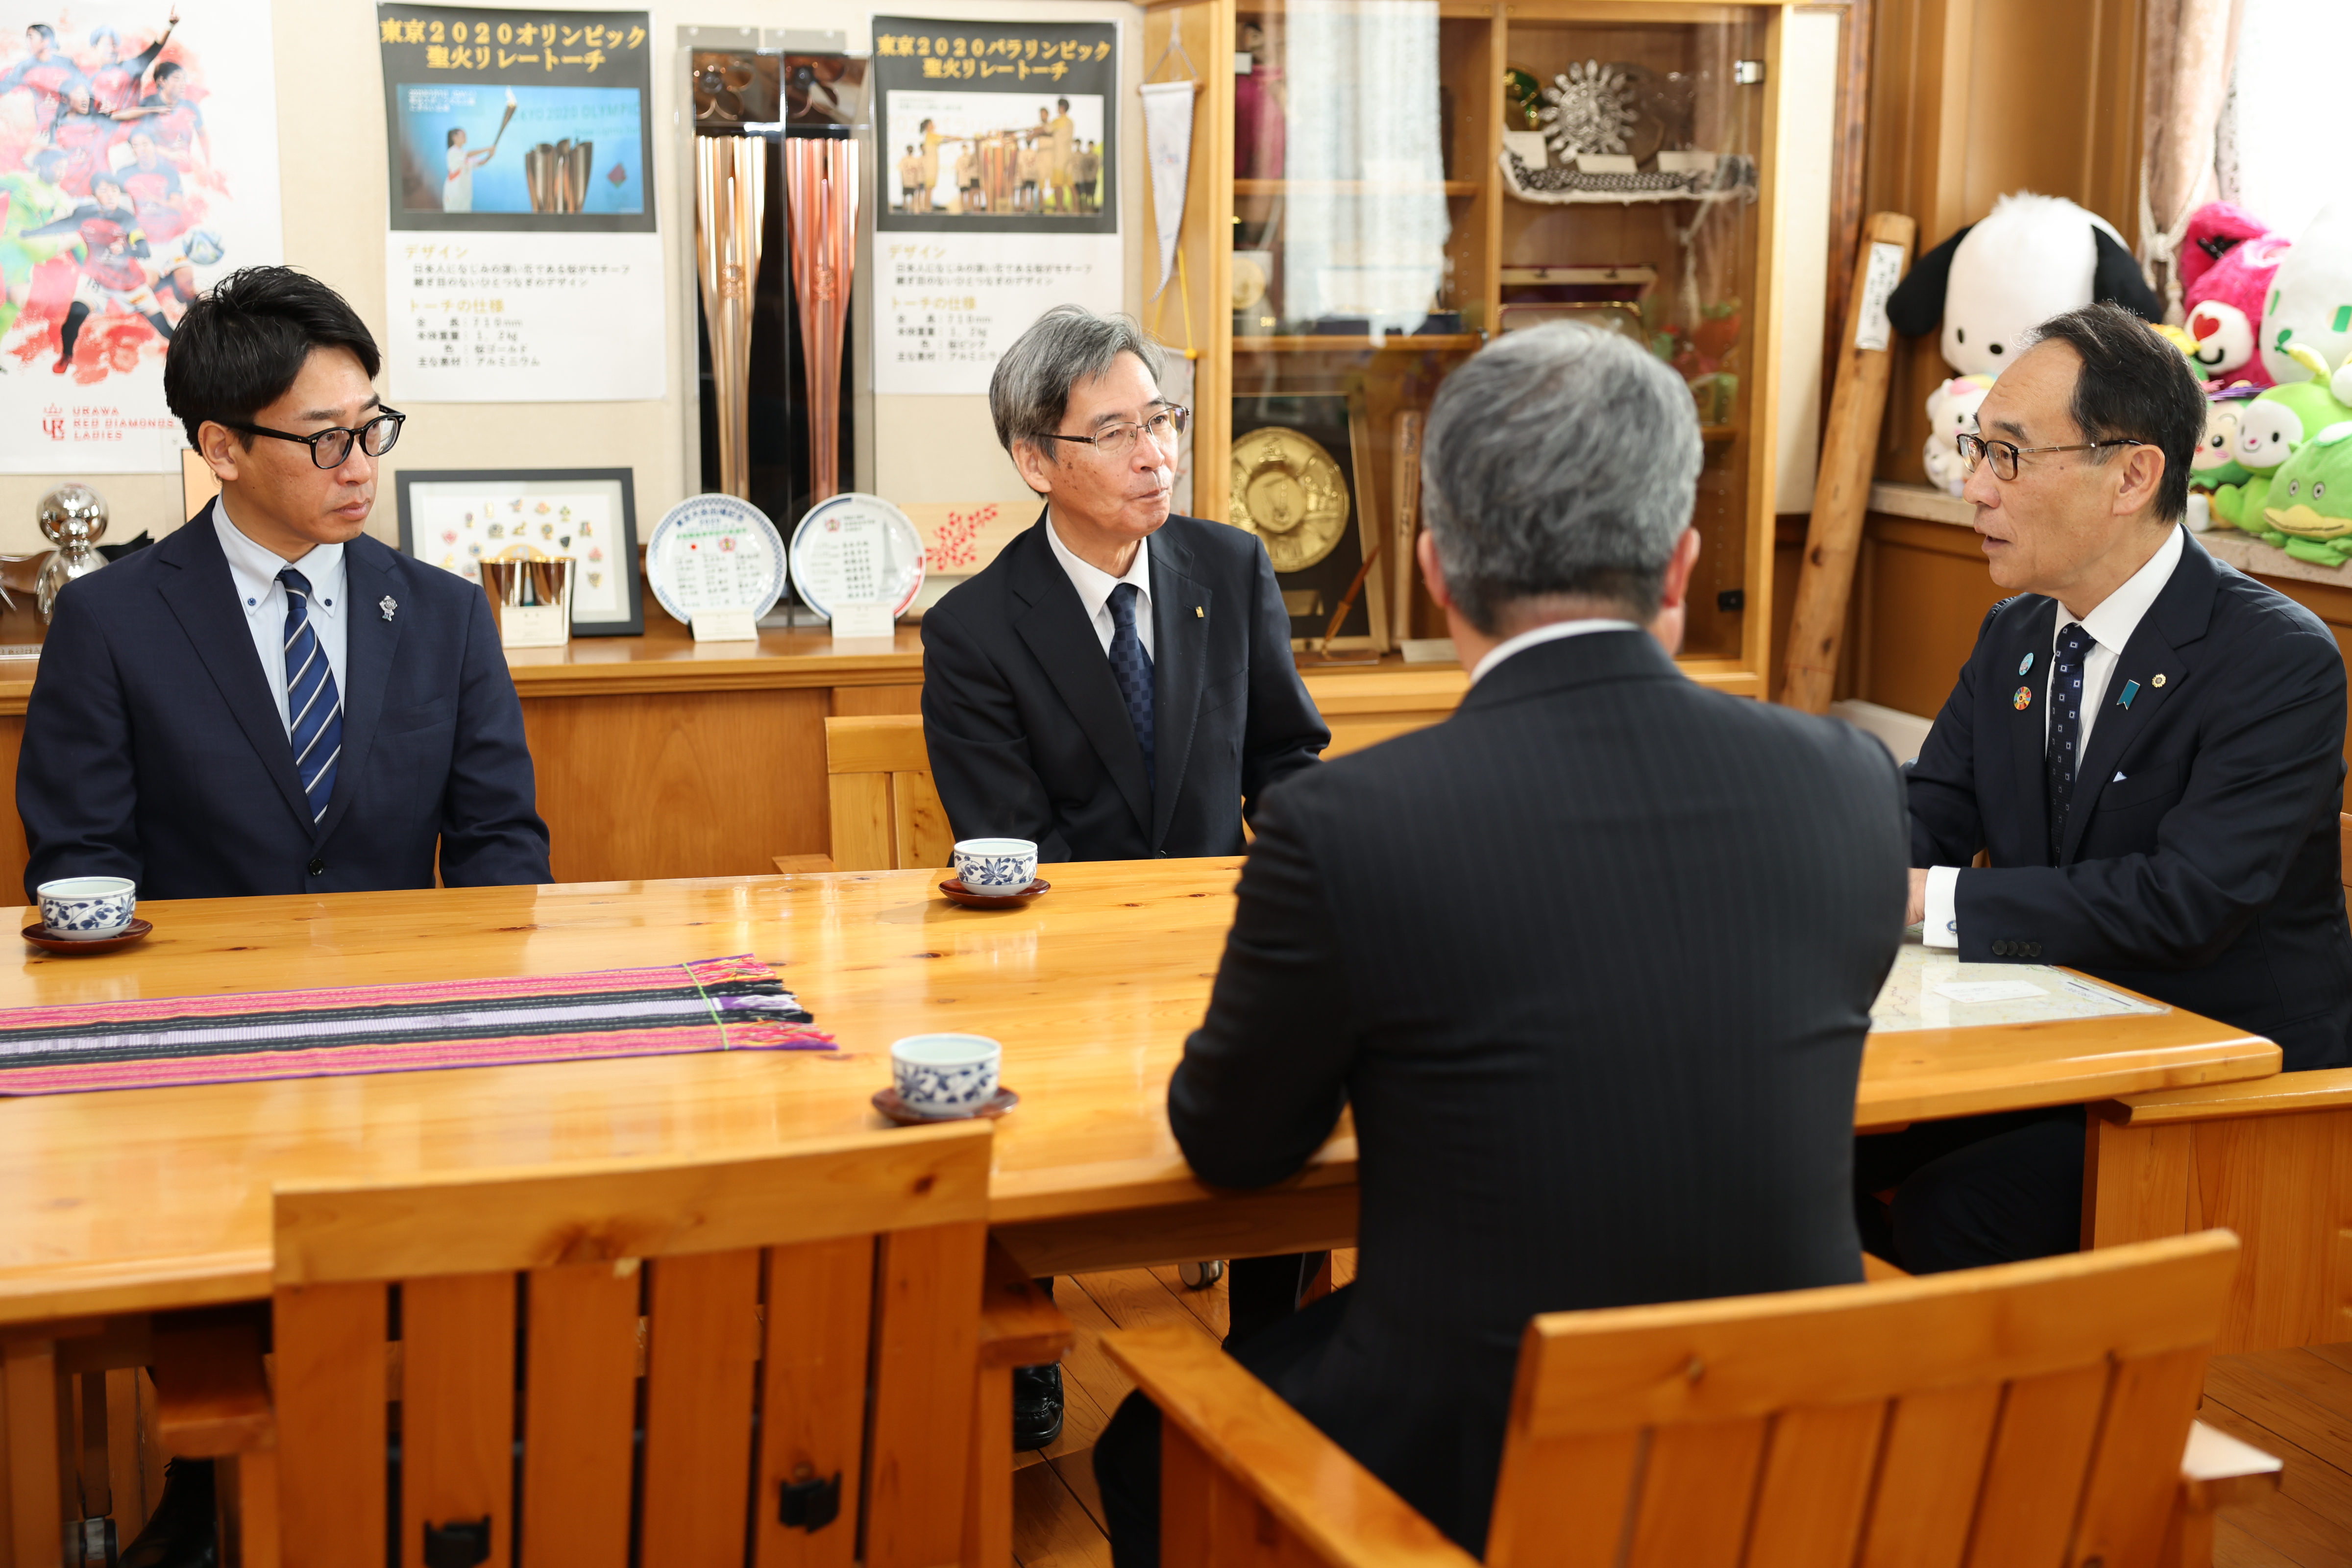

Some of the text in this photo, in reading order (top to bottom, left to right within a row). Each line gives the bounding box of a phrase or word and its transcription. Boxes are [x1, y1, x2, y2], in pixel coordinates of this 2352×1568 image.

[380, 17, 646, 49] 東京2020オリンピック
[877, 34, 1111, 62] 東京2020パラリンピック
[426, 45, 606, 73] 聖火リレートーチ
[922, 57, 1069, 82] 聖火リレートーチ
[405, 244, 468, 260] デザイン
[889, 245, 946, 259] デザイン
[410, 298, 505, 314] トーチの仕様
[891, 295, 977, 311] トーチの仕様
[73, 406, 120, 417] URAWA
[74, 418, 175, 429] RED DIAMONDS
[74, 430, 123, 441] LADIES
